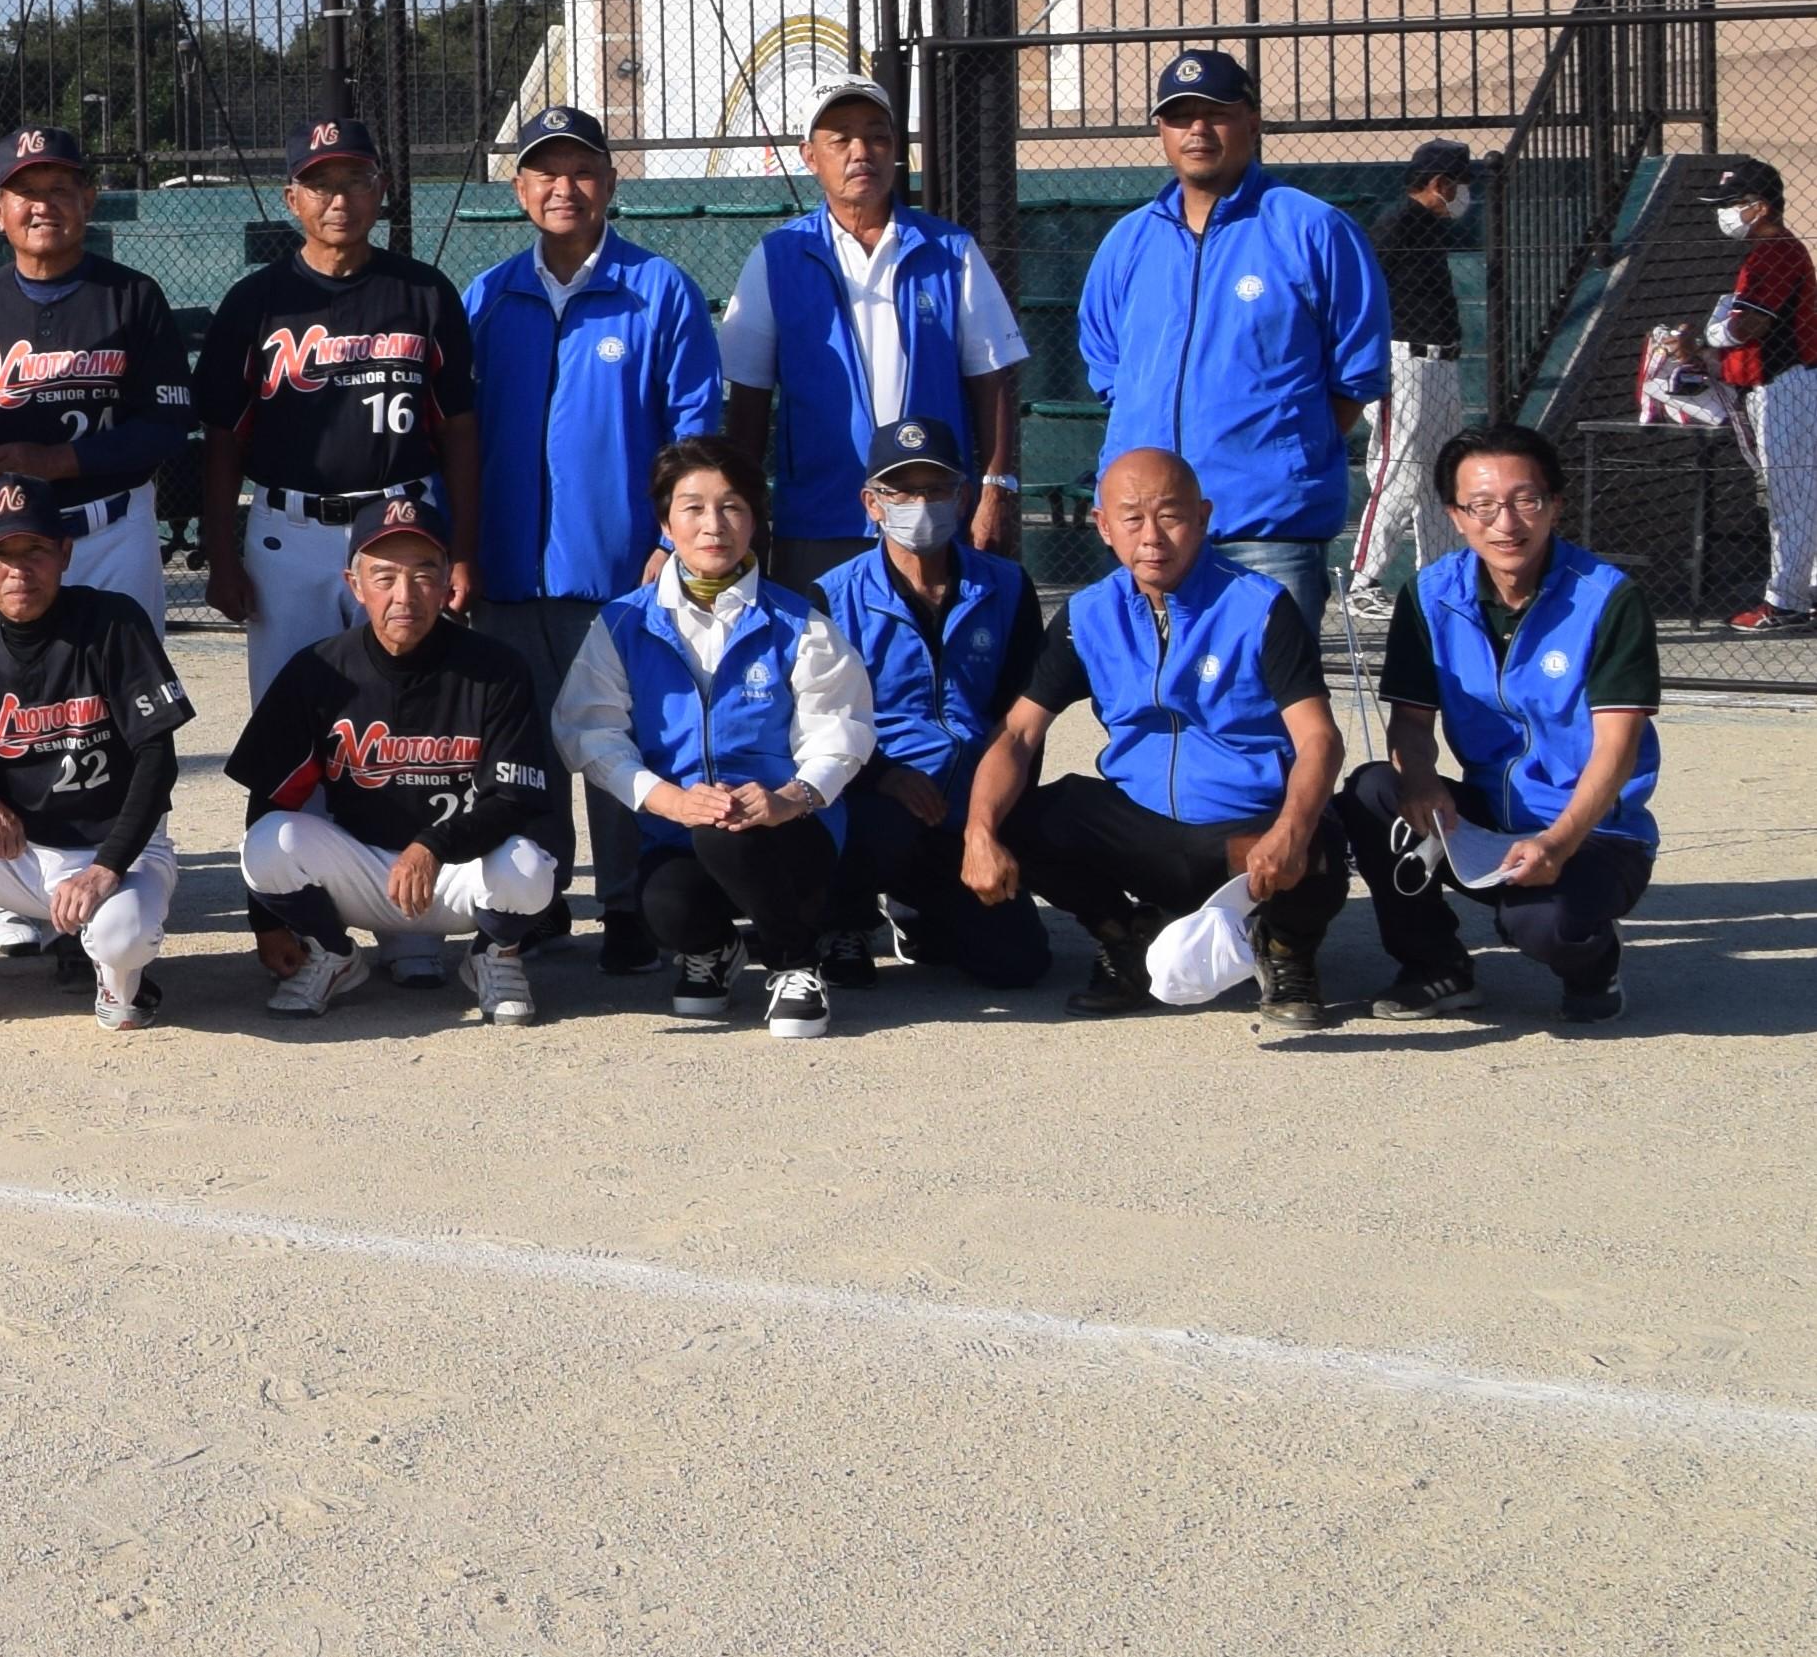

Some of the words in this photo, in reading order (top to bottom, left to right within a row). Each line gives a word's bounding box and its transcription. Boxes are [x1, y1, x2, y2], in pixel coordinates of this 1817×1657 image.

[315, 333, 426, 366] NOTOGAWA
[333, 370, 386, 388] SENIOR
[392, 370, 423, 386] CLUB
[36, 389, 86, 404] SENIOR
[362, 391, 415, 436] 16
[80, 730, 112, 749] CLUB
[378, 734, 484, 765] NOTOGAW
[52, 748, 111, 793] 22
[394, 772, 452, 787] SENIOR
[495, 760, 548, 792] SHIGA
